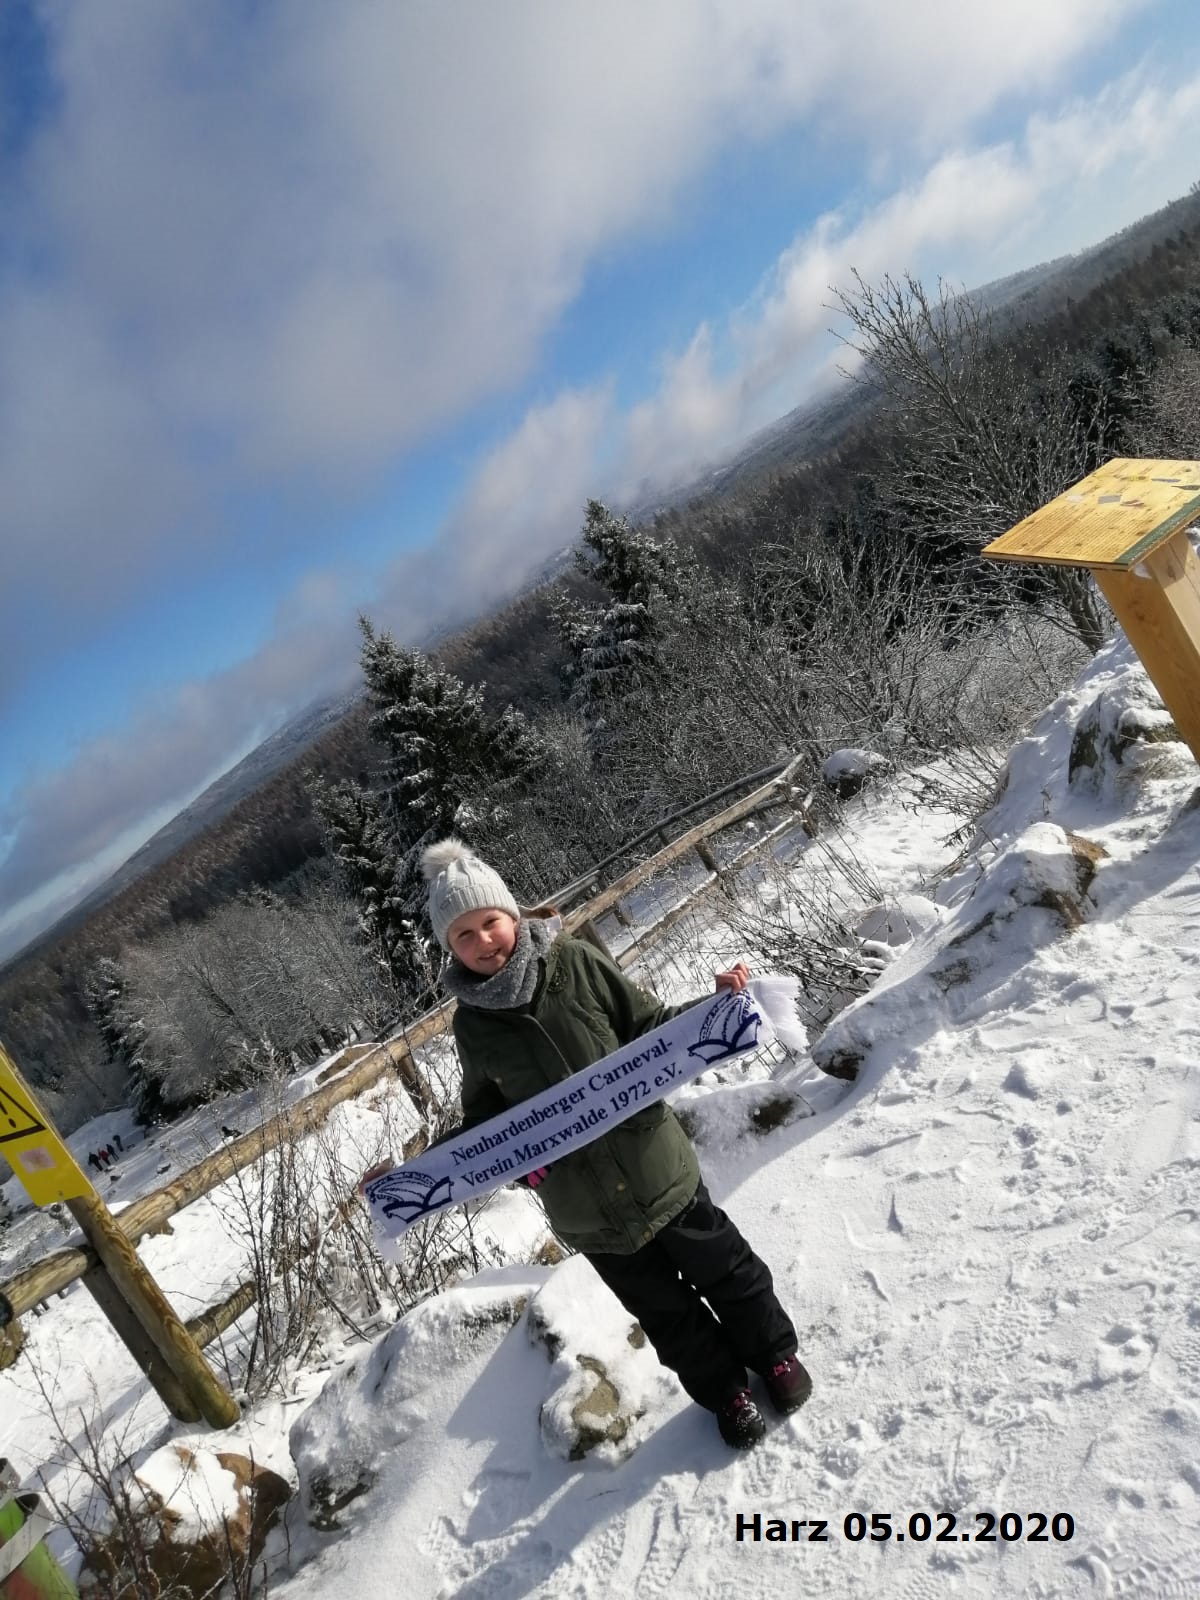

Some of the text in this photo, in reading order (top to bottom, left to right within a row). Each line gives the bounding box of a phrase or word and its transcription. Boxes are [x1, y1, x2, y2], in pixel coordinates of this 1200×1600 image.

[450, 1038, 673, 1166] Neuhardenberger Carneval-
[461, 1062, 683, 1187] Verein Marxwalde 1972 e.V.
